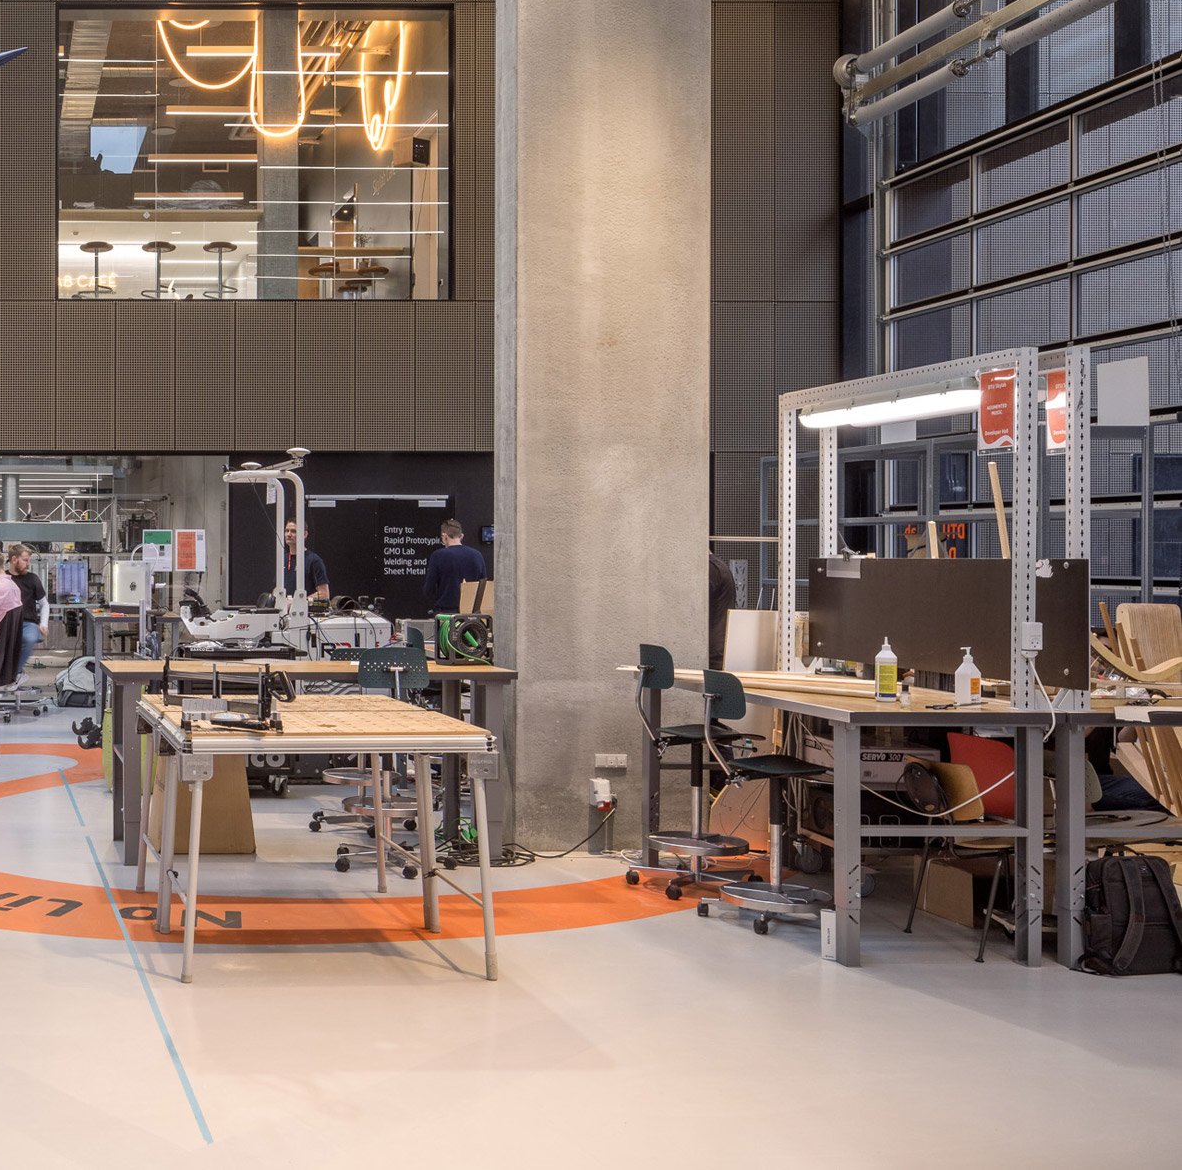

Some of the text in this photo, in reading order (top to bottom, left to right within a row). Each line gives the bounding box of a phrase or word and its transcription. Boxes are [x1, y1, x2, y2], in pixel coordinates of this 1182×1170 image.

[383, 525, 415, 535] Entry to:
[383, 536, 404, 545] Rapid
[383, 547, 416, 555] GMO Lab
[383, 557, 428, 567] Welding and
[383, 567, 426, 575] Sheet Metal
[861, 752, 902, 762] SERVO 300
